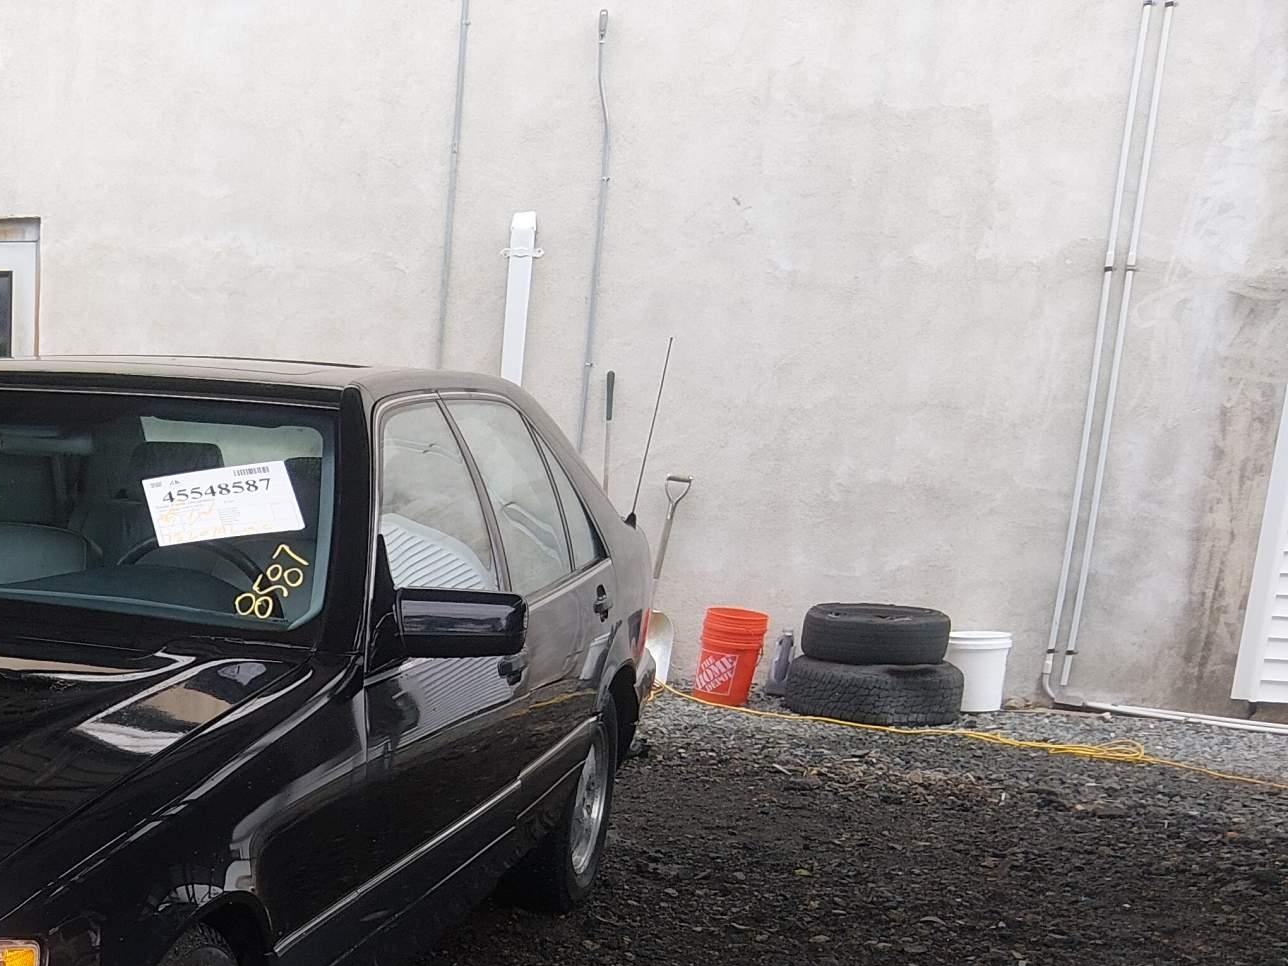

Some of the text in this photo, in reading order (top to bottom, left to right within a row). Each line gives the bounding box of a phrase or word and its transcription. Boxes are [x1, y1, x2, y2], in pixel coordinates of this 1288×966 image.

[162, 478, 271, 503] 45548587
[695, 654, 737, 690] HOME
[701, 655, 716, 668] THE
[705, 669, 733, 692] DEPOT
